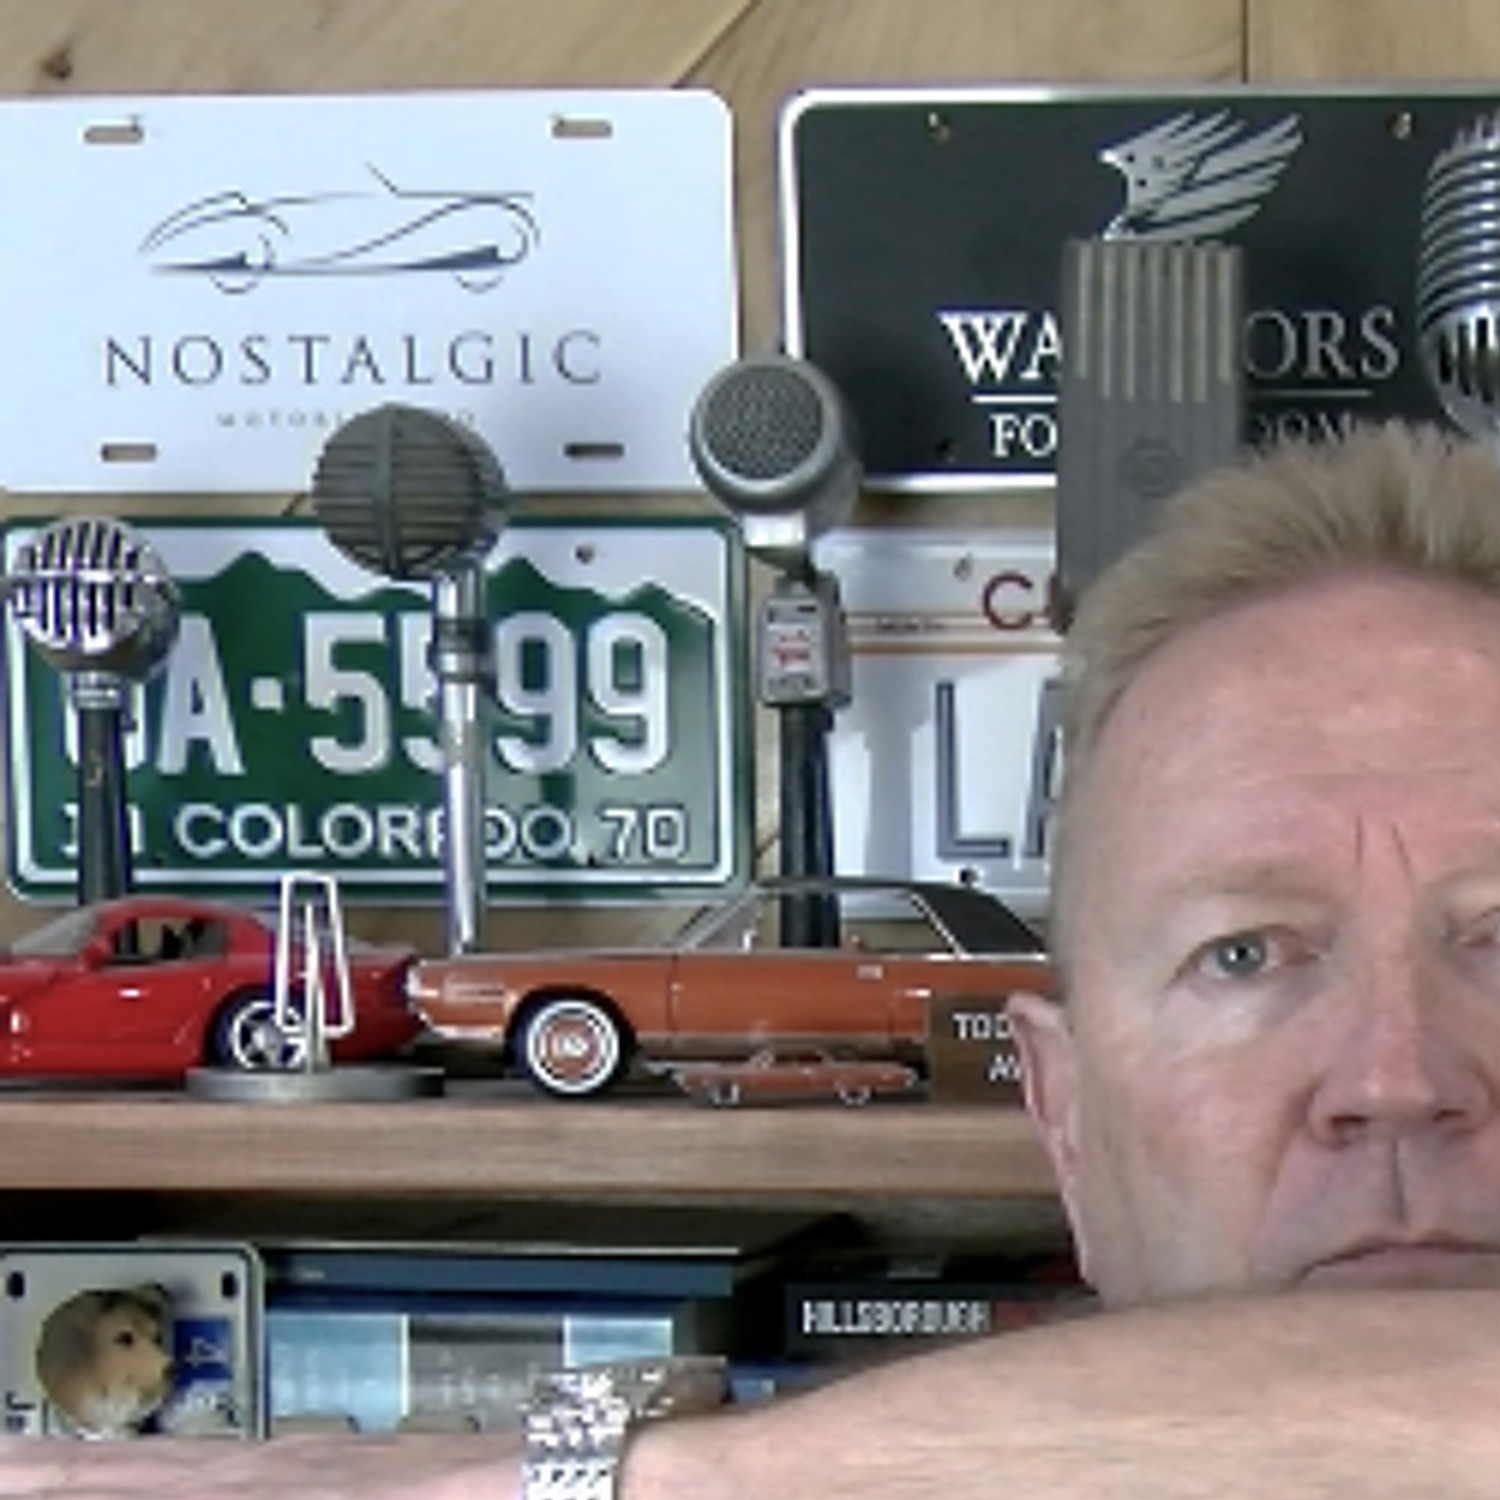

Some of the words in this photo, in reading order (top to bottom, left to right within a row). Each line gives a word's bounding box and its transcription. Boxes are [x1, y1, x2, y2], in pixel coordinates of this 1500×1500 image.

[104, 334, 602, 386] NOSTALGIC
[937, 309, 1398, 384] WAORS
[989, 412, 1058, 457] FO
[602, 807, 686, 858] 70
[802, 1300, 994, 1335] HILLSBOROUGH
